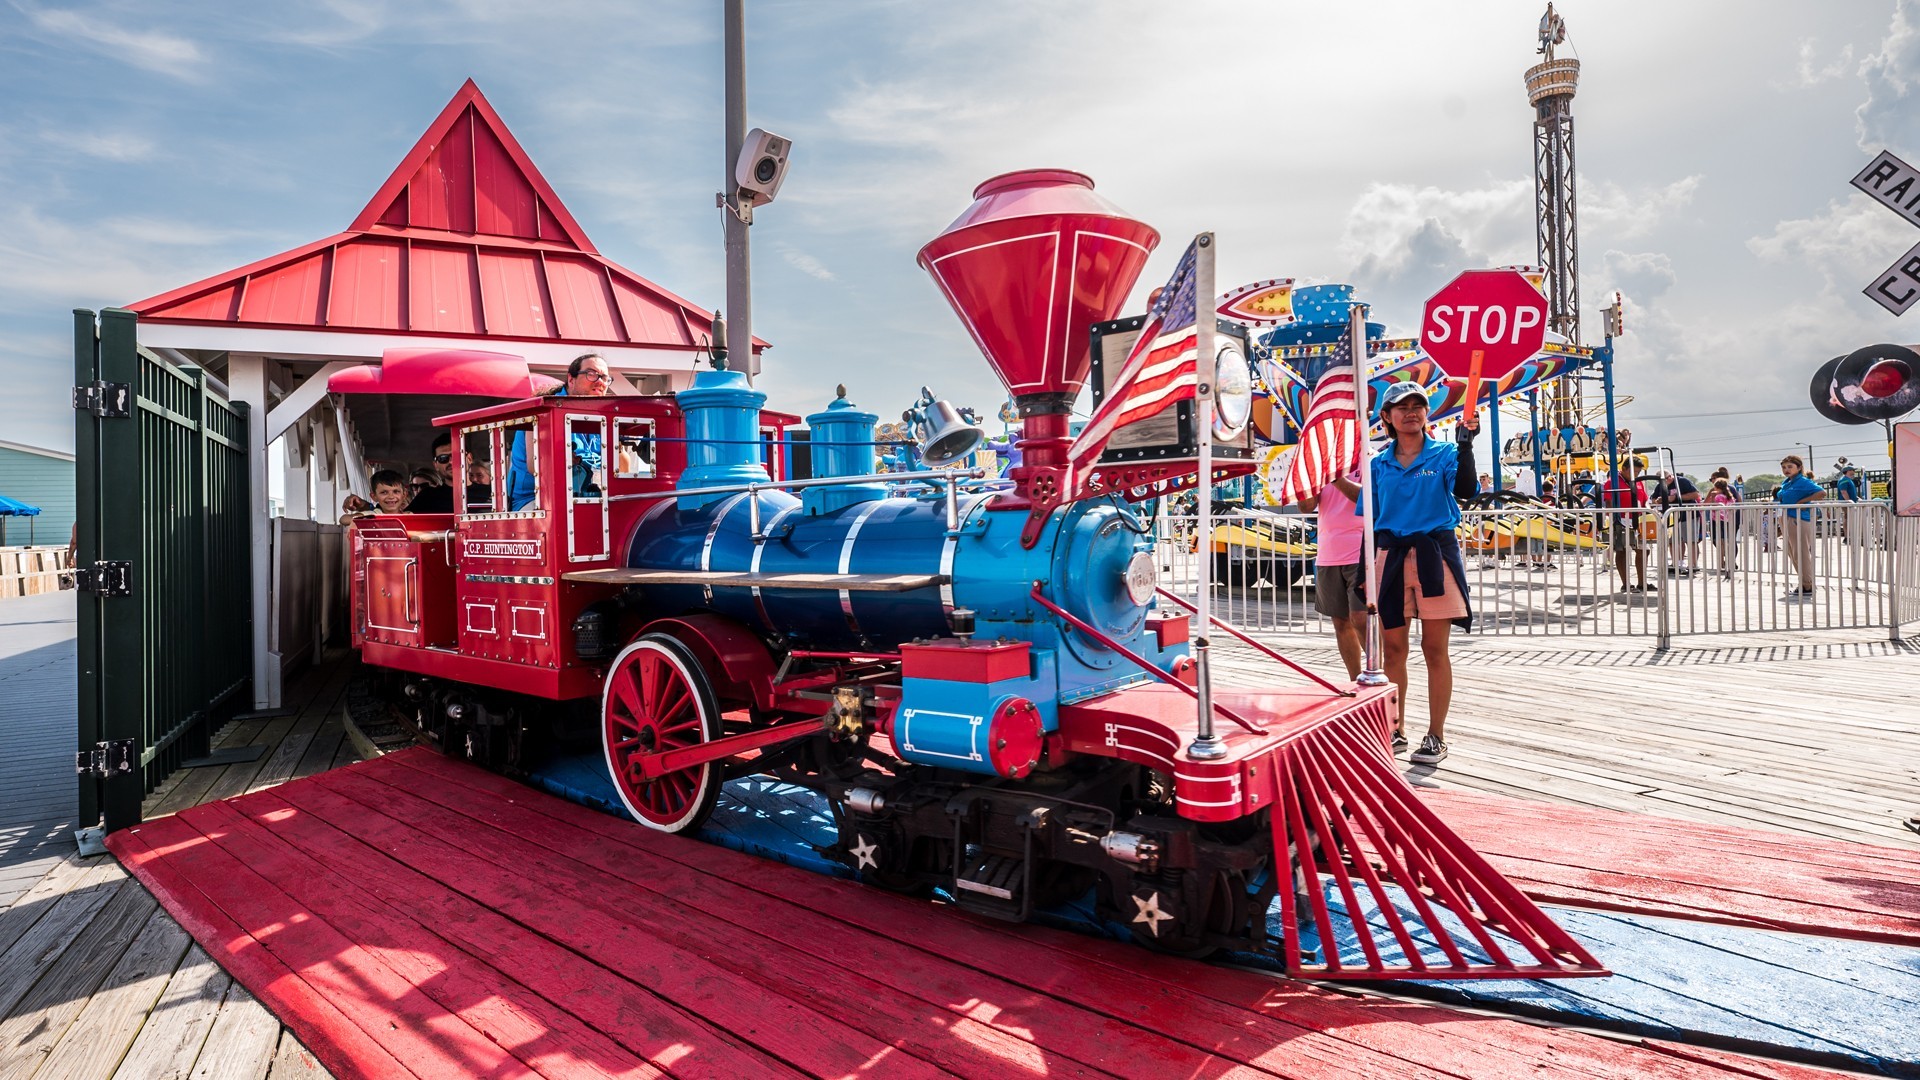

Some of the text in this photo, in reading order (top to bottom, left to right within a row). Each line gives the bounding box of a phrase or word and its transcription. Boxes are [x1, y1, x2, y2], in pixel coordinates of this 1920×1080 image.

[1862, 159, 1920, 218] RAI
[1427, 304, 1541, 345] STOP
[469, 543, 534, 555] C.P. HUNTINGTON
